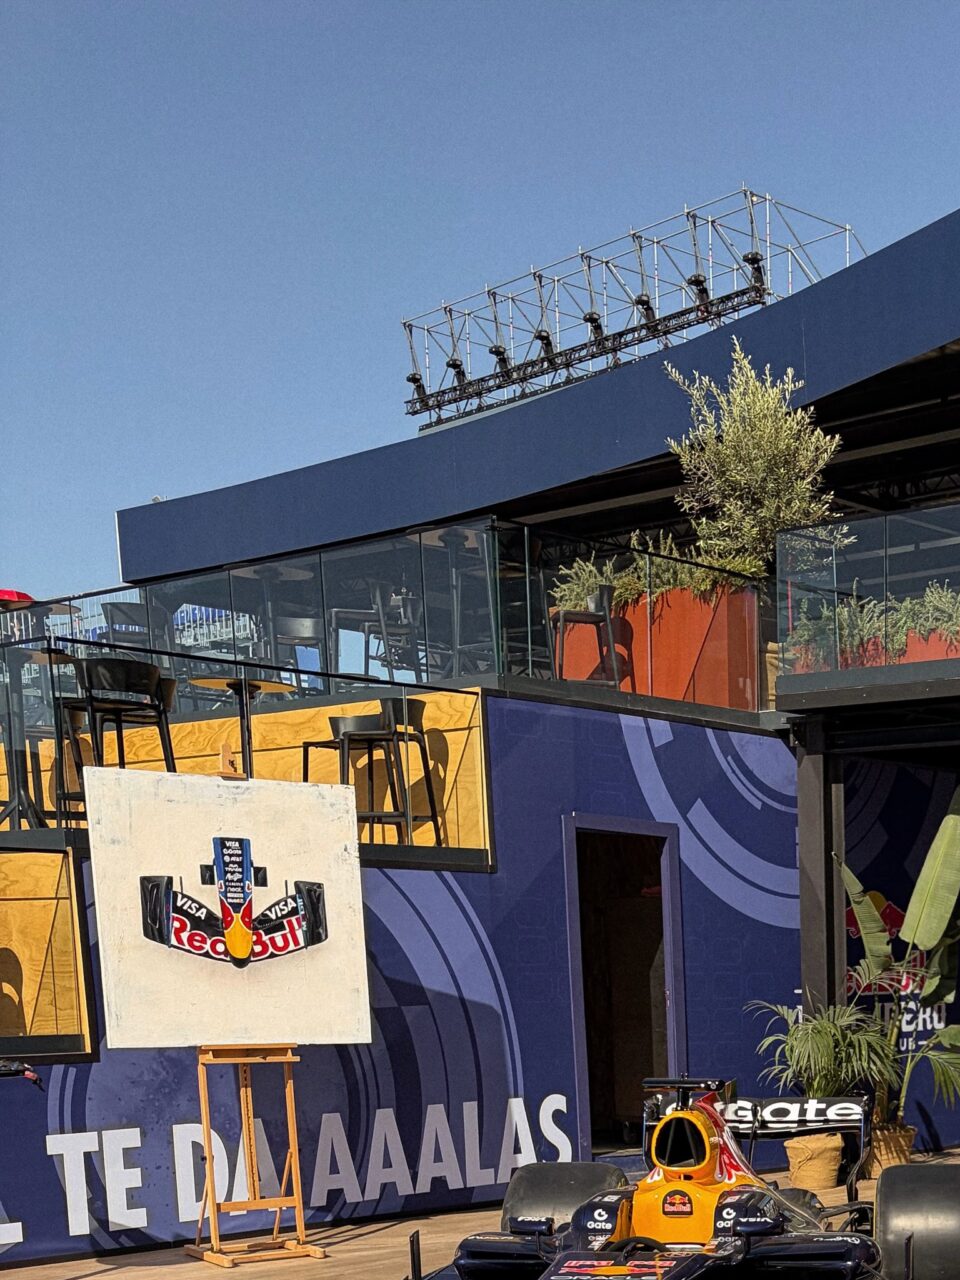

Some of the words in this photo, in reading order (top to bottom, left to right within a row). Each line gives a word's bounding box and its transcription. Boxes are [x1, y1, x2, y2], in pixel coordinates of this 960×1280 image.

[176, 892, 208, 921] VISA
[263, 897, 298, 922] VISA
[46, 1127, 148, 1236] TE
[310, 1093, 572, 1207] AAALAS
